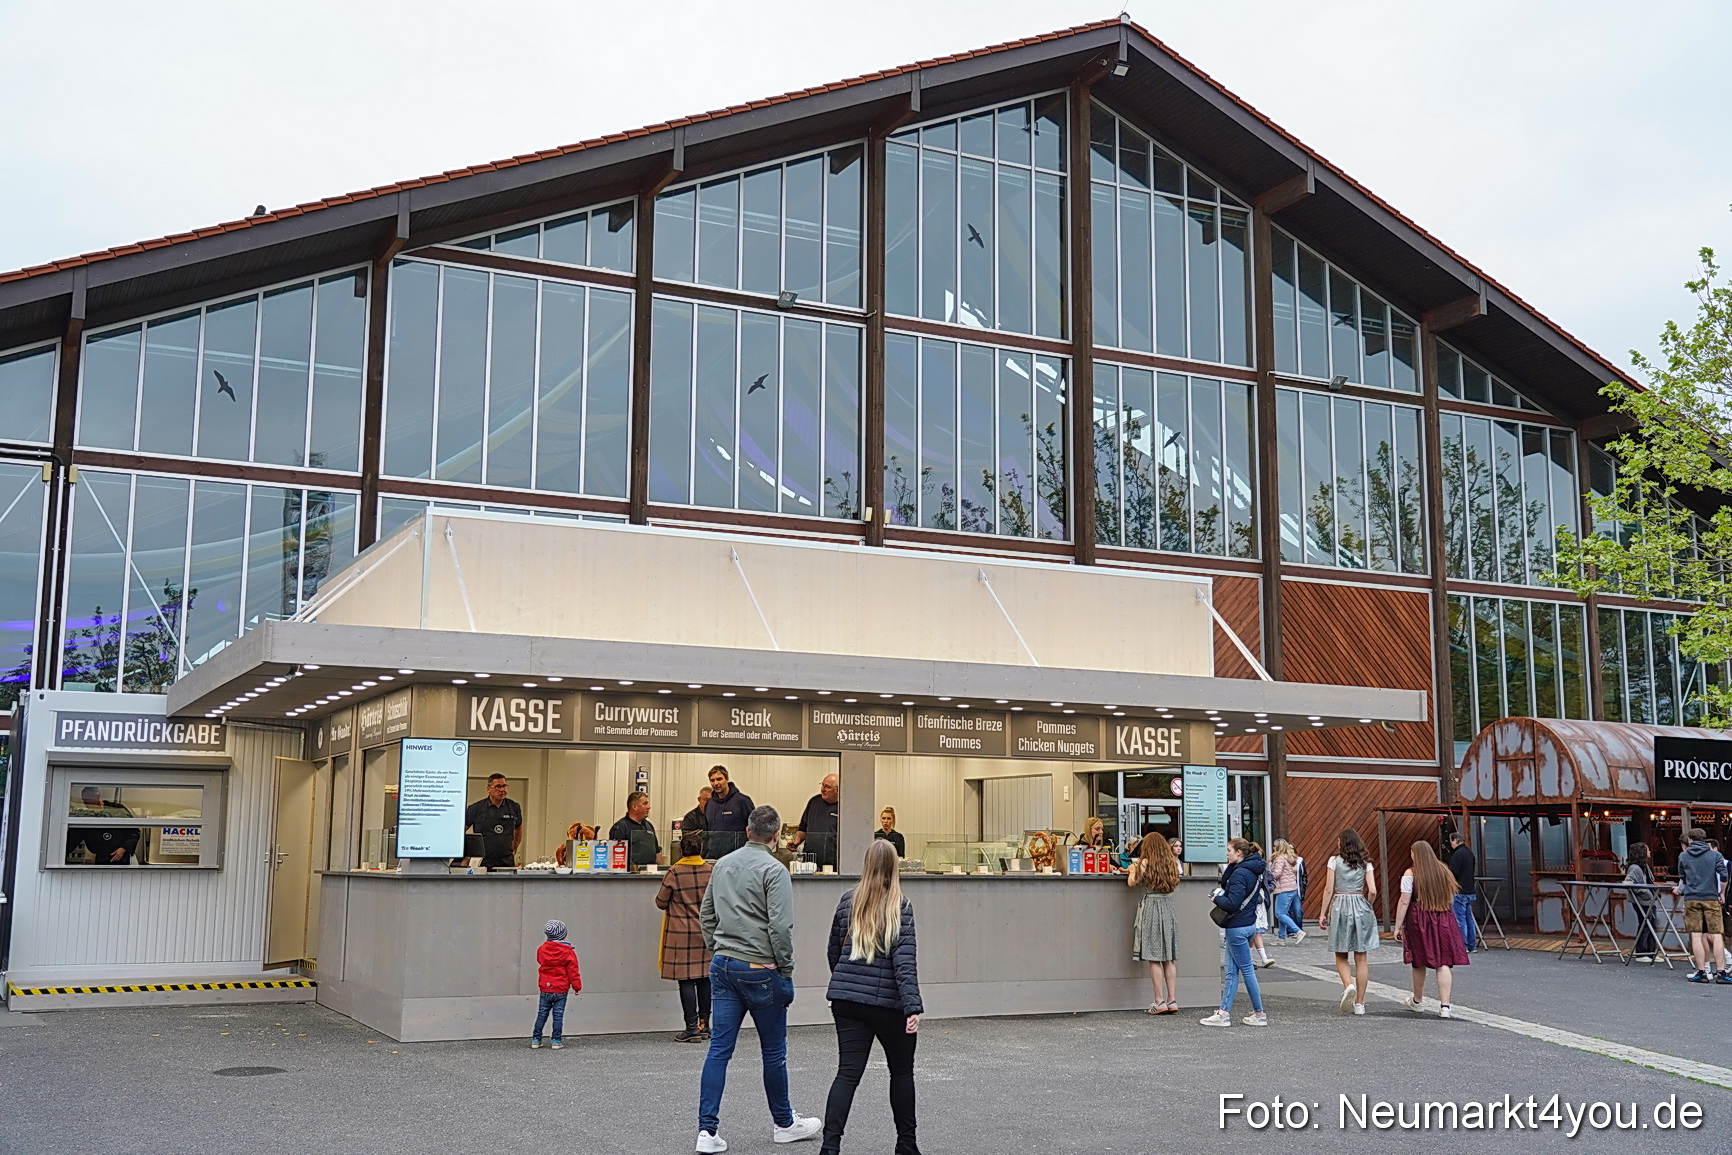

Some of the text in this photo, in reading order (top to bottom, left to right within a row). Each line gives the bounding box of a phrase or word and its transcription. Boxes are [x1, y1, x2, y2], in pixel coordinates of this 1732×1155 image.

[470, 696, 563, 734] KASSE
[594, 702, 679, 726] Currywurst
[731, 707, 772, 727] Steak
[812, 709, 904, 728] Bratwurstsemmel
[917, 715, 1003, 732] Ofenfrische Breze
[61, 719, 221, 745] PFANDRÜCKGABE
[594, 724, 679, 737] mit Semmel oder Pommes
[701, 728, 799, 741] in der Semmel oder mit Pommes
[836, 729, 881, 743] Härteis
[1036, 720, 1077, 735] Pommes
[940, 734, 982, 750] Pommes
[1018, 737, 1095, 756] Chicken Nuggets
[1116, 725, 1182, 757] KASSE
[1663, 759, 1732, 781] PROSEC
[163, 828, 200, 836] HACKL
